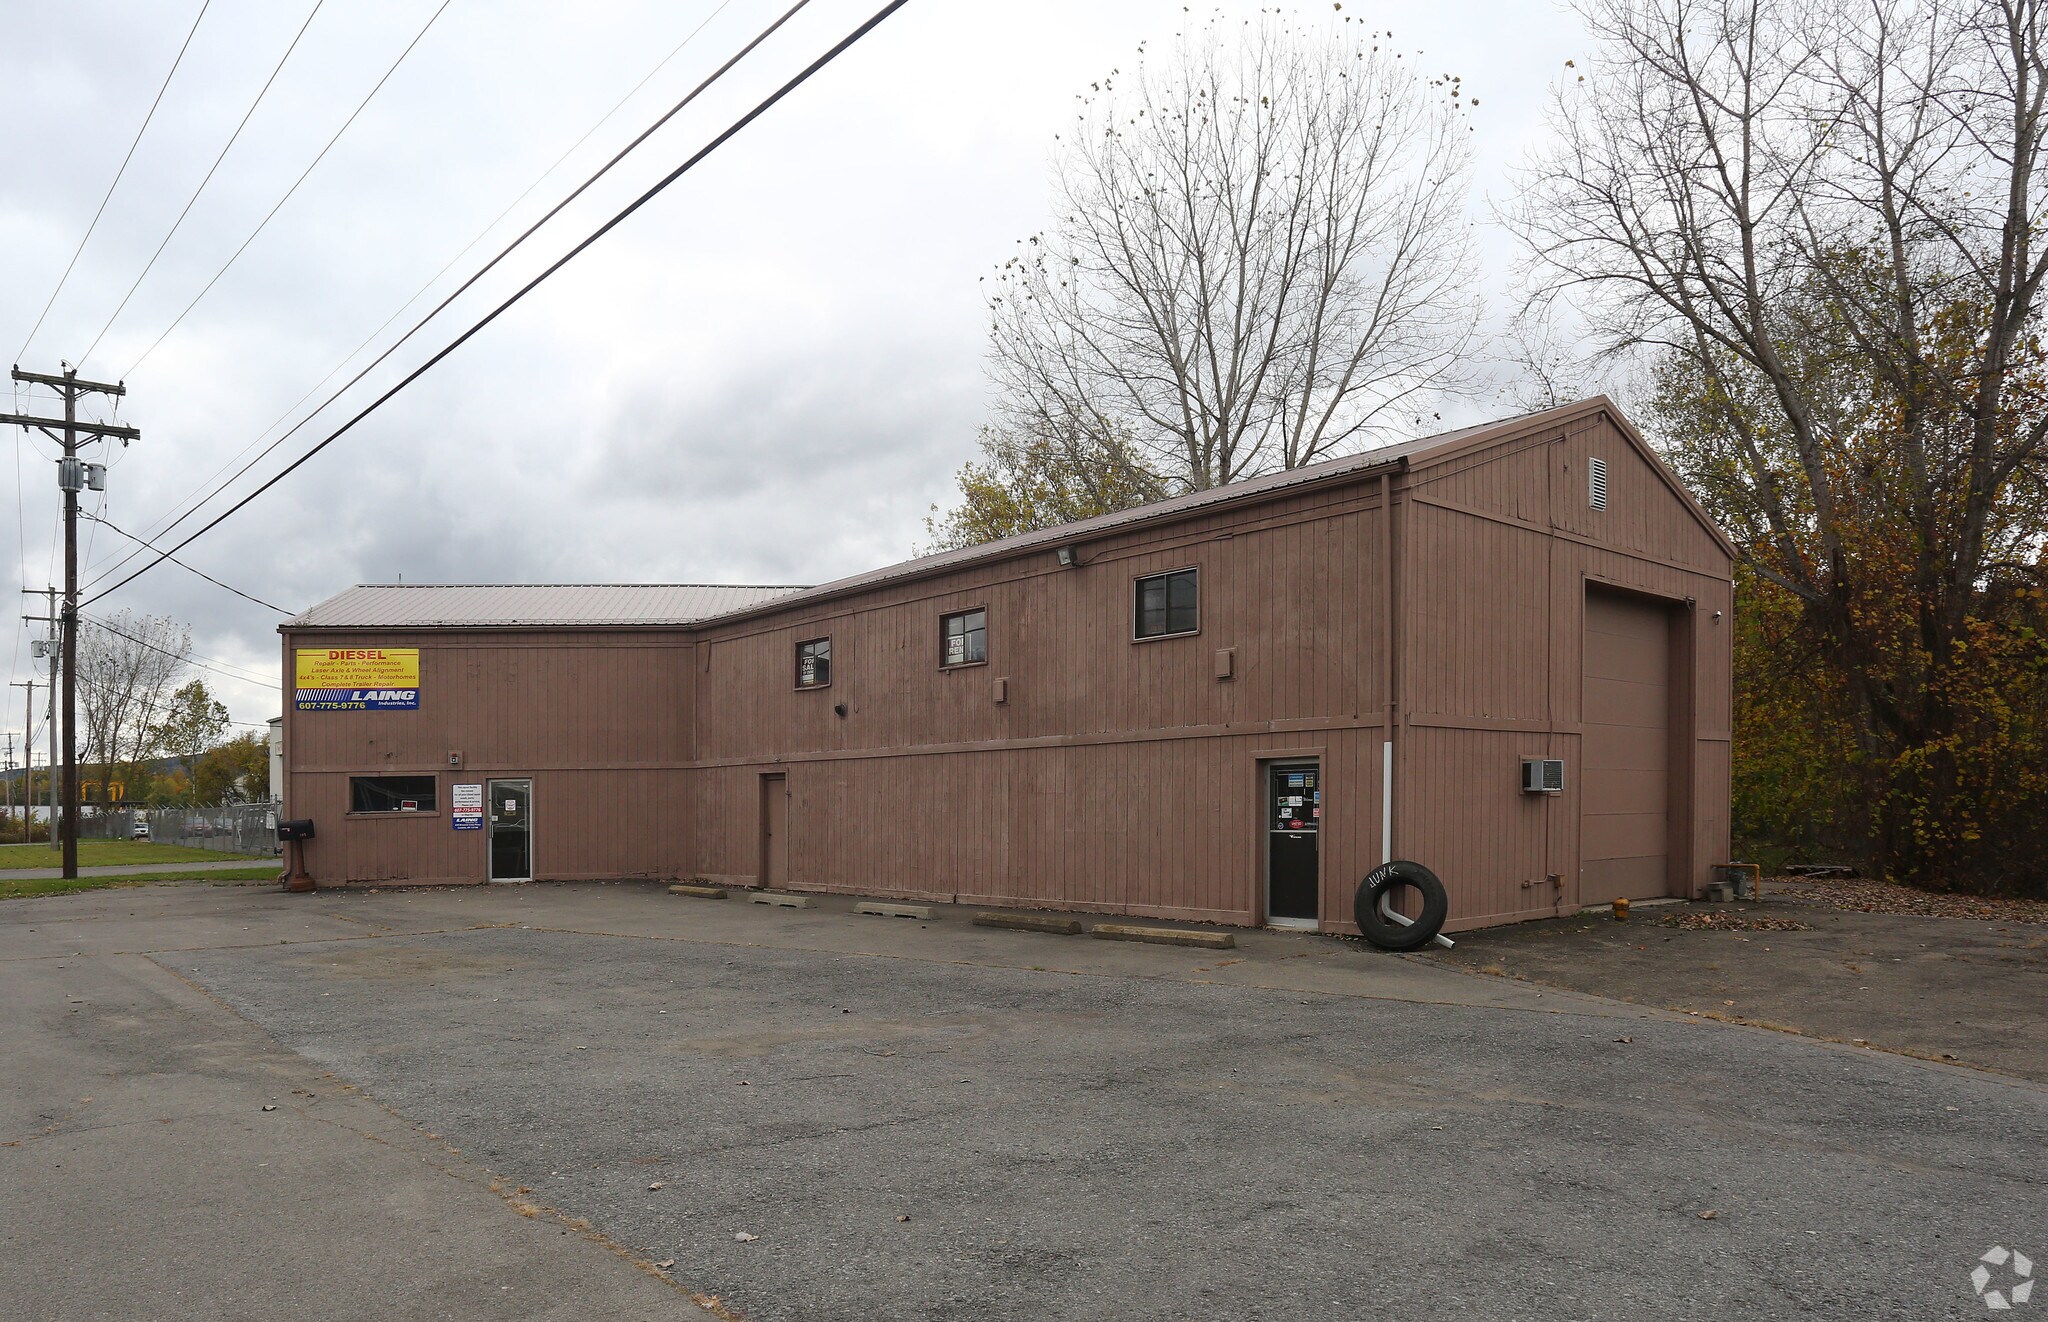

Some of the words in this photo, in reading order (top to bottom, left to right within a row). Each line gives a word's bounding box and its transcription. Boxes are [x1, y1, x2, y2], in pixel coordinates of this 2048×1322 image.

[951, 638, 963, 647] FO
[329, 650, 386, 660] DIESEL
[351, 691, 416, 701] LAING
[299, 702, 366, 710] 607-775-9776
[1368, 865, 1399, 888] JUNK
